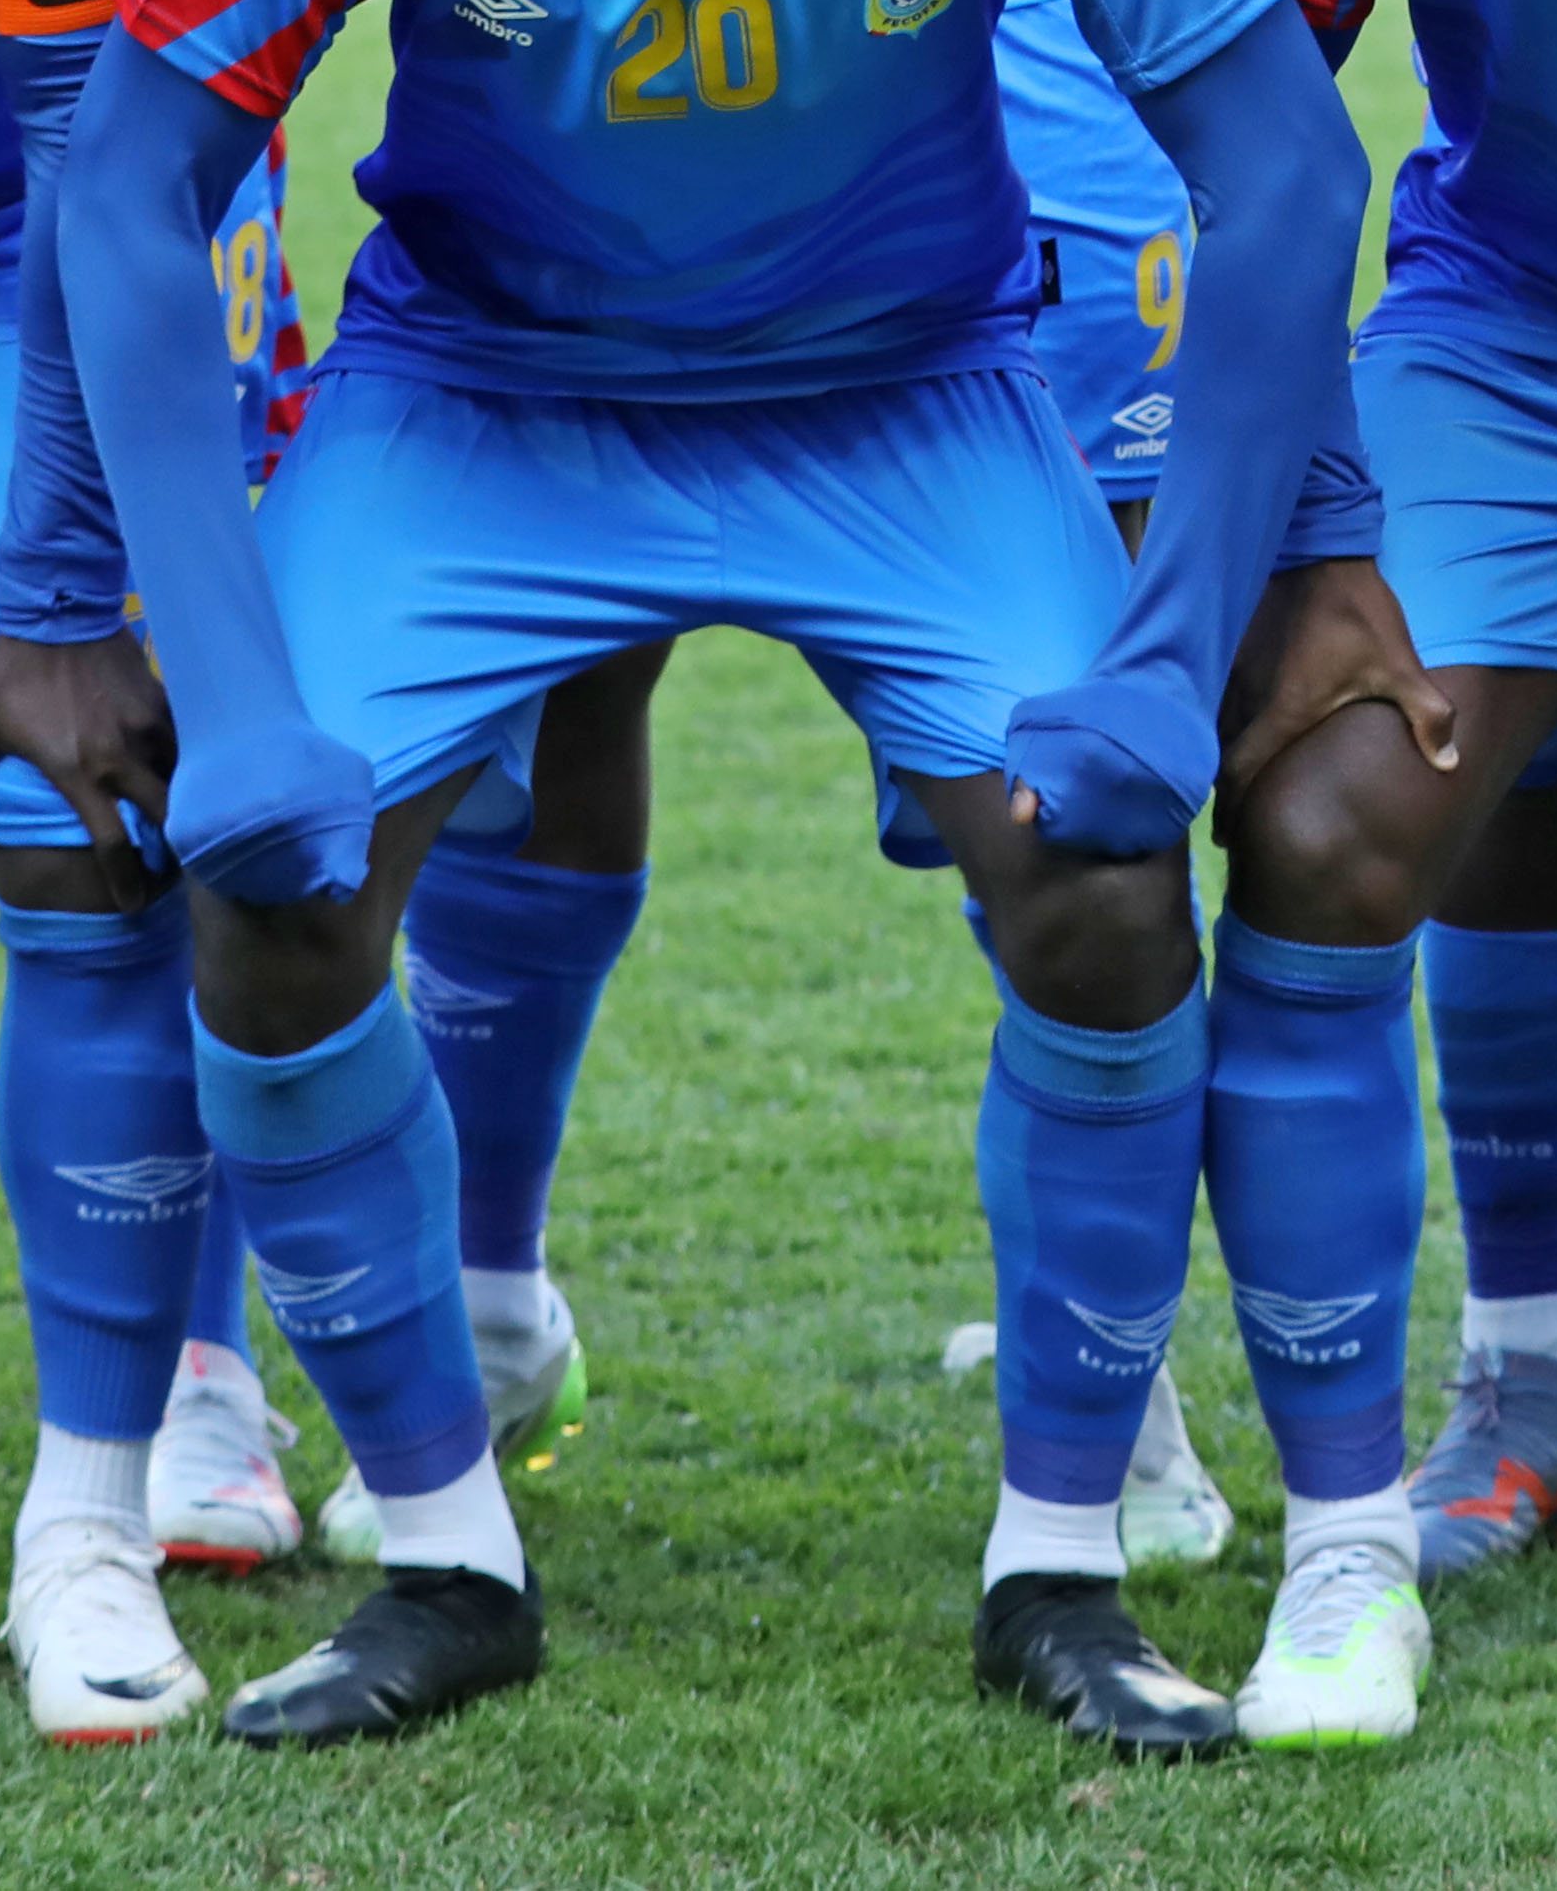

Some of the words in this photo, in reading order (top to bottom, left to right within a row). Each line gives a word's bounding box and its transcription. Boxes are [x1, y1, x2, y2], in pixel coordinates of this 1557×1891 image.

[453, 3, 534, 48] umbro
[883, 0, 940, 28] FECOFA
[211, 219, 267, 364] 8
[1115, 437, 1169, 460] umbr
